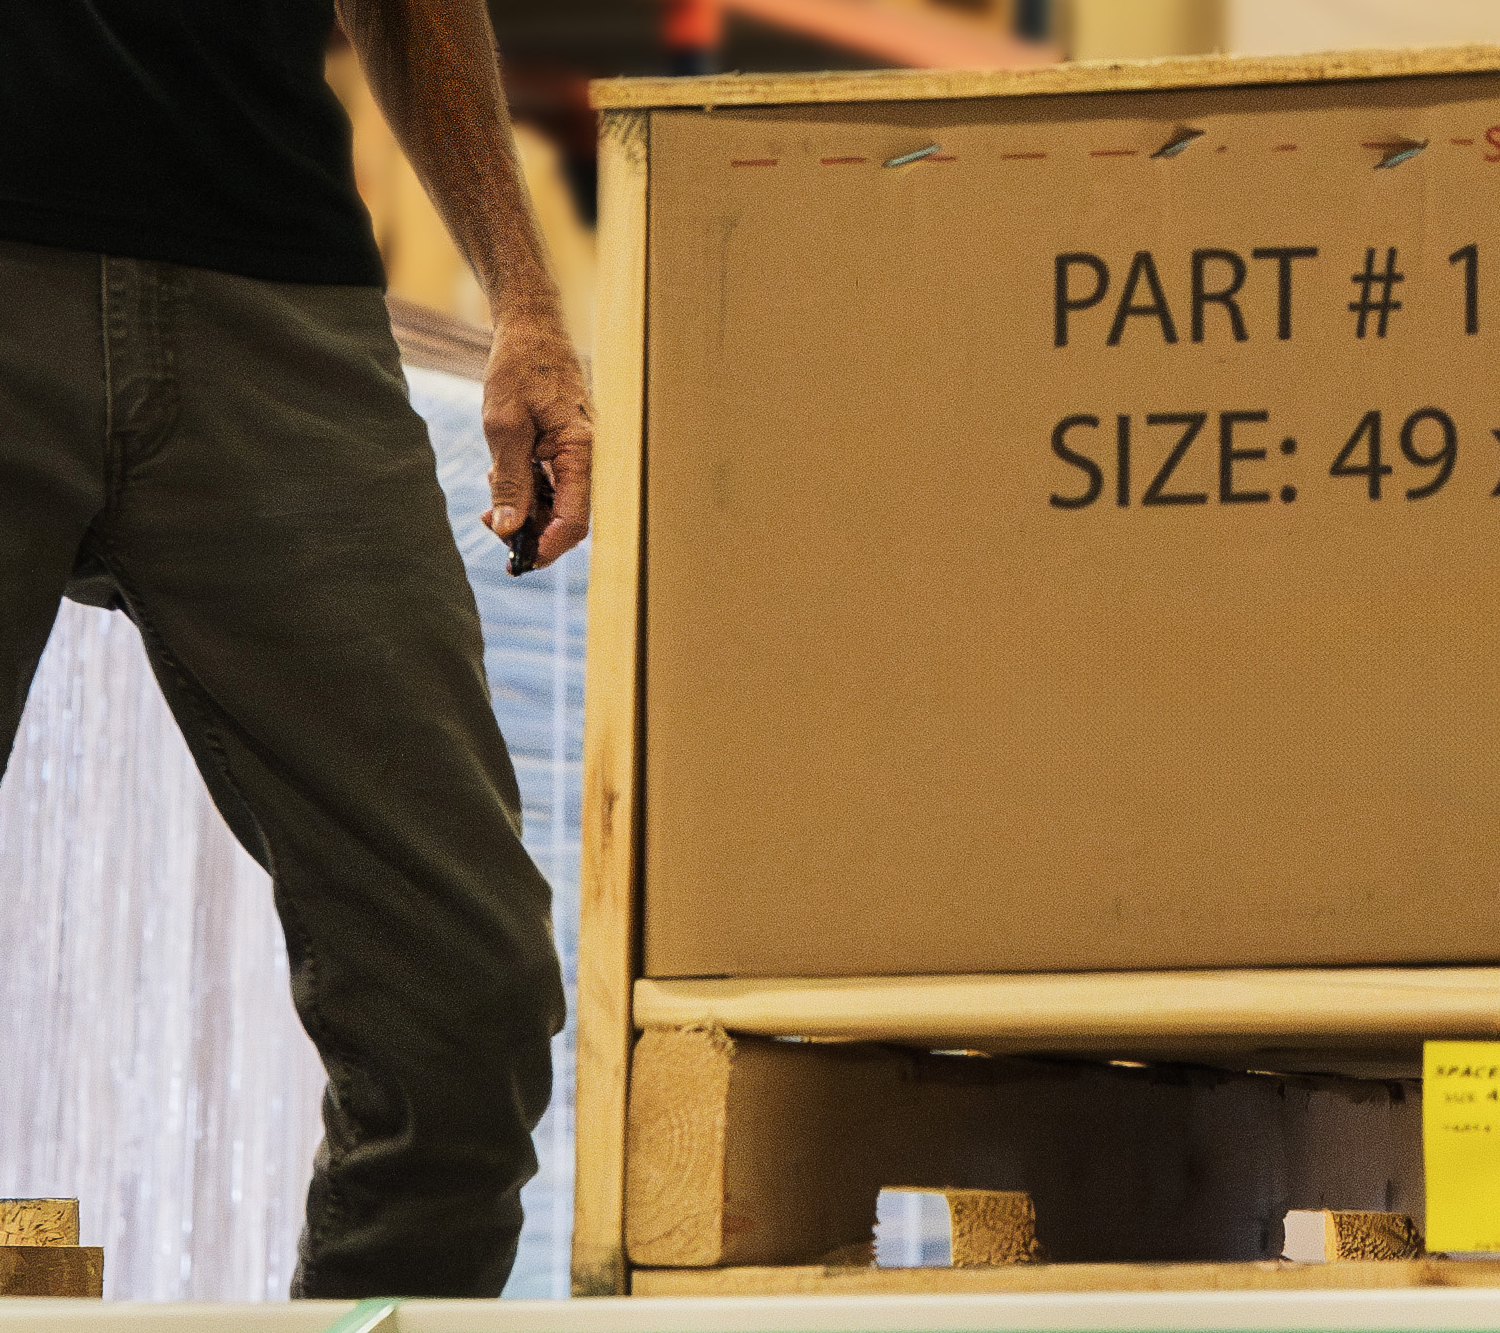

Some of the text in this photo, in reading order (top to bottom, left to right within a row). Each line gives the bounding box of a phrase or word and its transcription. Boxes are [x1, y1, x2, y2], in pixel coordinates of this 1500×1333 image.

[1053, 244, 1319, 347] PART
[1348, 245, 1405, 339] #
[1048, 408, 1299, 509] SIZE:
[1328, 403, 1458, 501] 49
